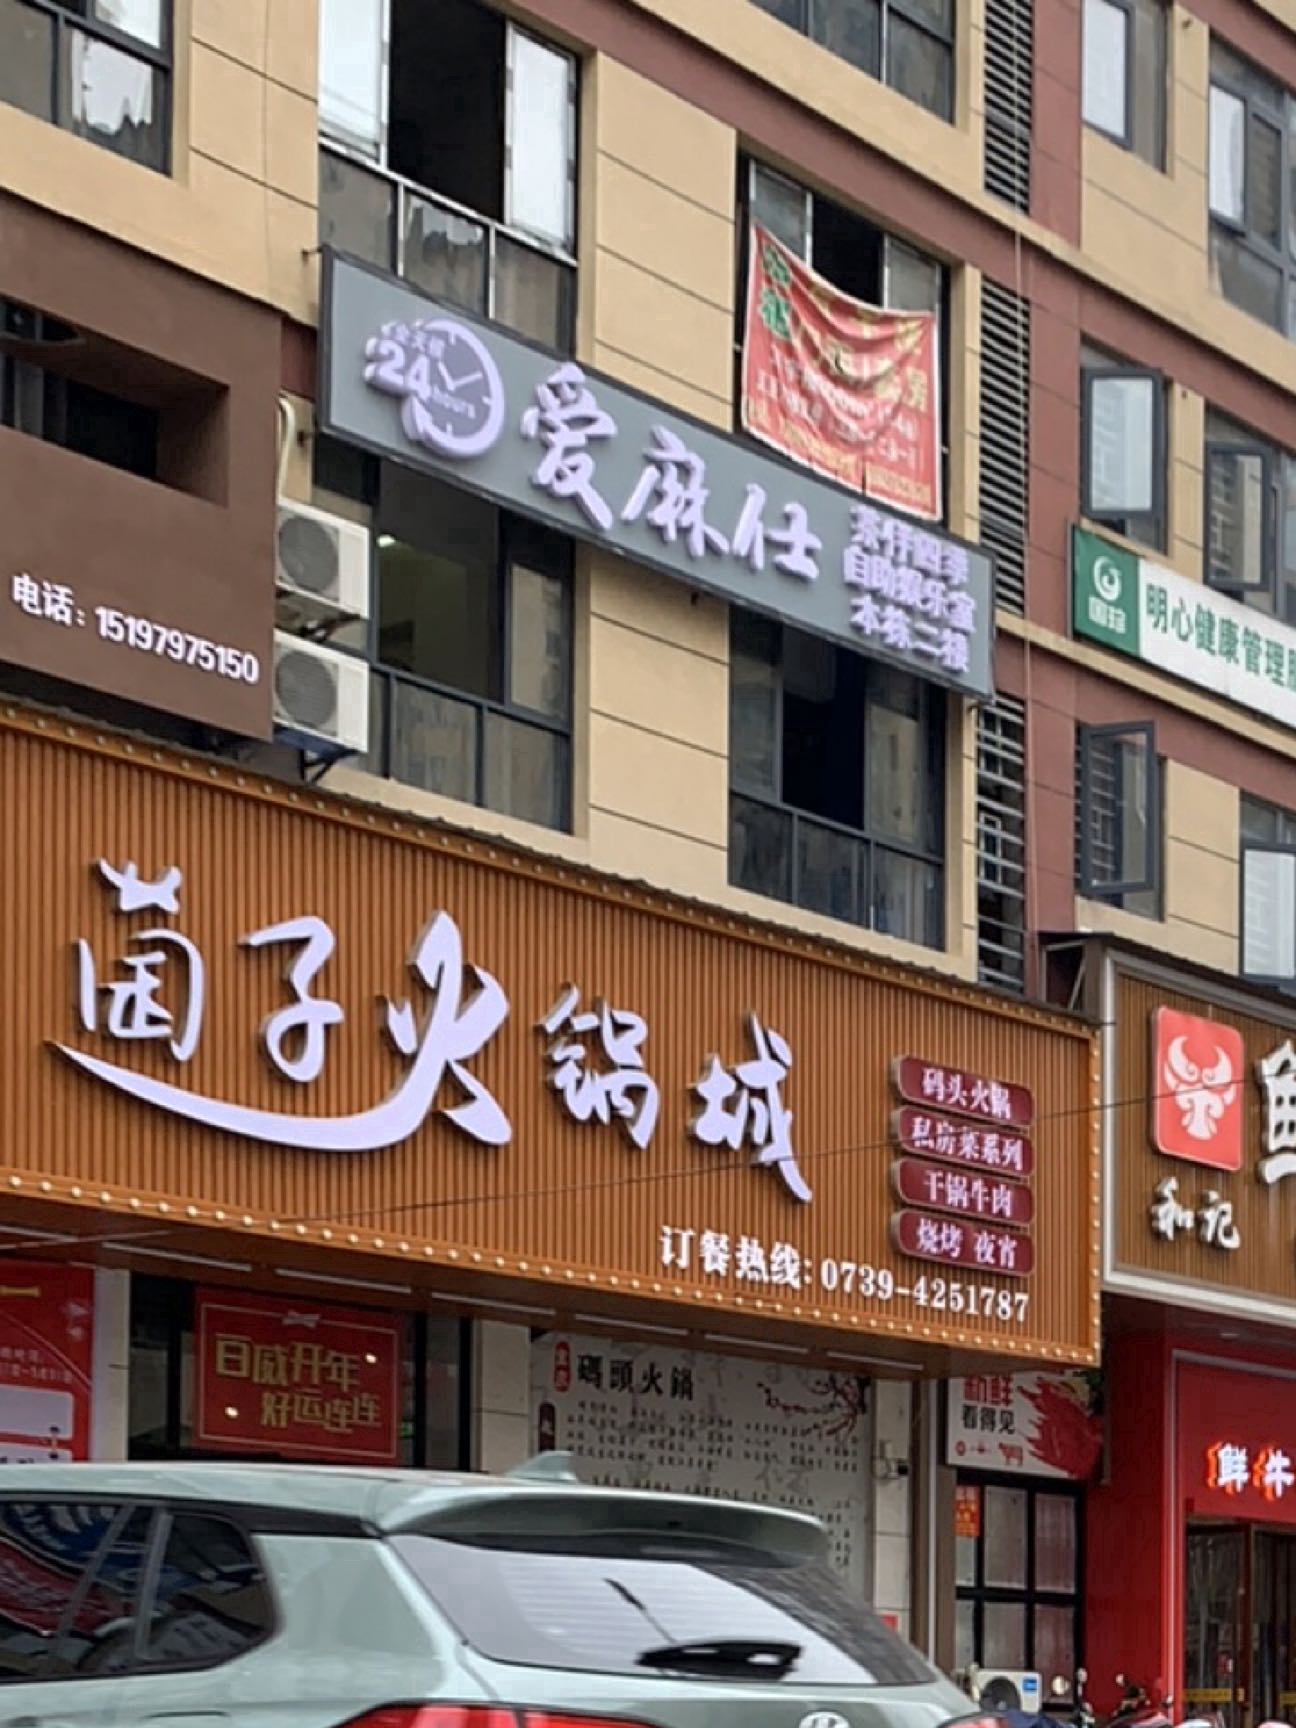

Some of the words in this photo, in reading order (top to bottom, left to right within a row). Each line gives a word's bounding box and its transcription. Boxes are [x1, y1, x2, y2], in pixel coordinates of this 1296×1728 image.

[521, 364, 823, 582] 爱麻仕
[922, 1067, 1011, 1120] 码头火锅
[911, 1115, 1024, 1172] 私房菜系列
[923, 1168, 1014, 1218] 干锅牛肉
[916, 1216, 963, 1258] 烧烤
[973, 1230, 1018, 1270] 夜宵
[260, 1388, 382, 1434] 好运连连
[963, 1404, 1016, 1435] 看得见
